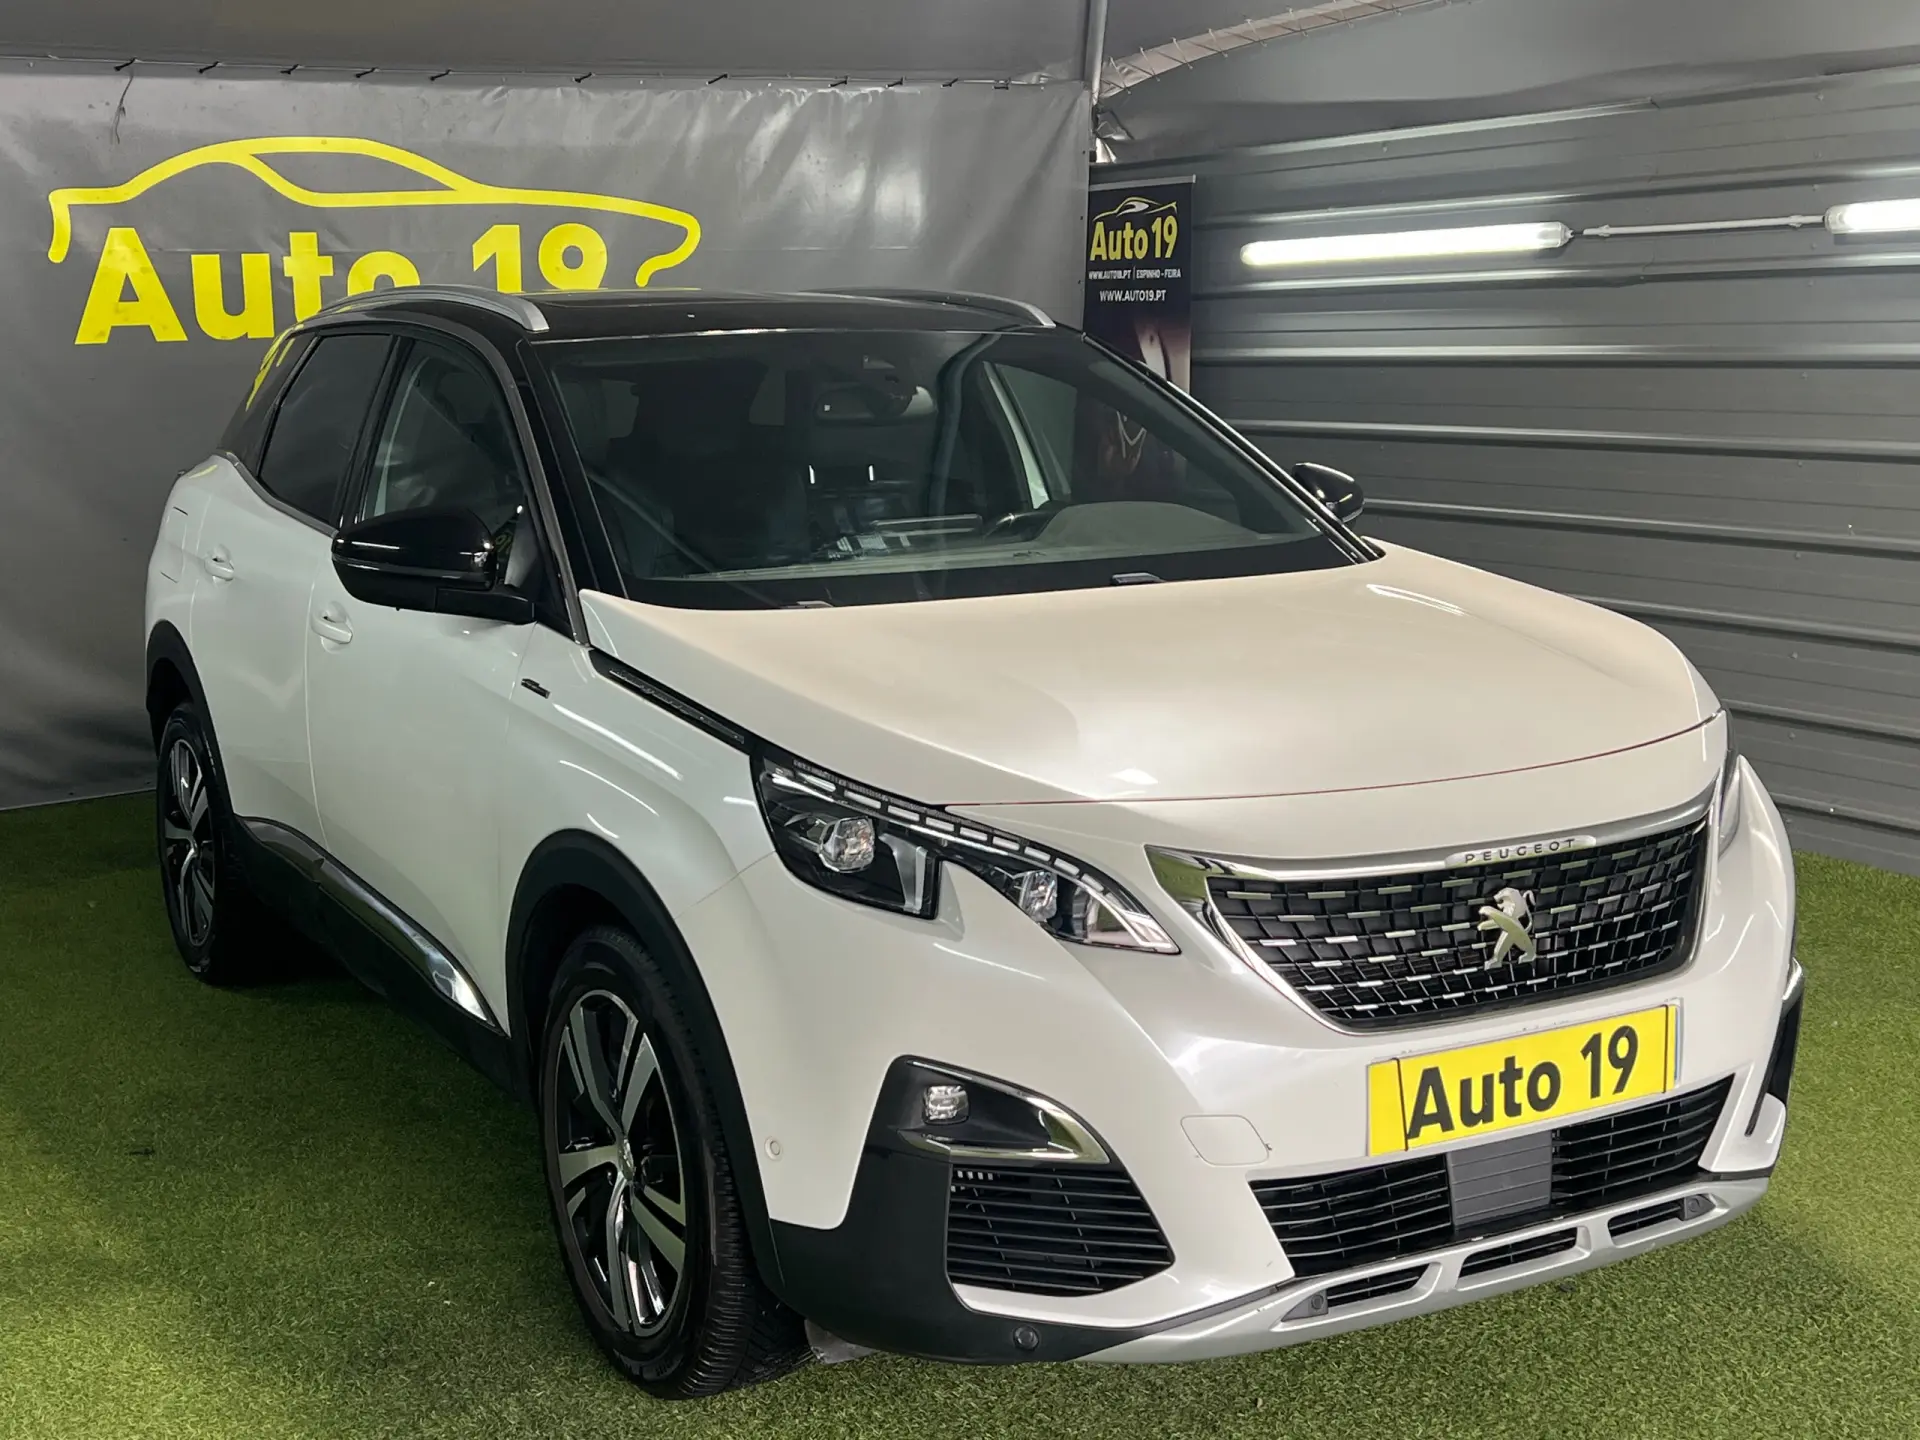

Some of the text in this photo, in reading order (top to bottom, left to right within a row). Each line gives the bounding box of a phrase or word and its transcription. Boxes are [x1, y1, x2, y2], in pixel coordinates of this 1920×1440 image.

[1090, 215, 1178, 261] Auto 19
[473, 223, 607, 293] 19
[1136, 269, 1160, 279] ESPINHO
[1164, 268, 1181, 278] FEIRA
[1099, 289, 1166, 302] WWW.AUTO19.PT
[1465, 838, 1575, 863] PEUGEOT
[1408, 1025, 1639, 1140] Auto 19
